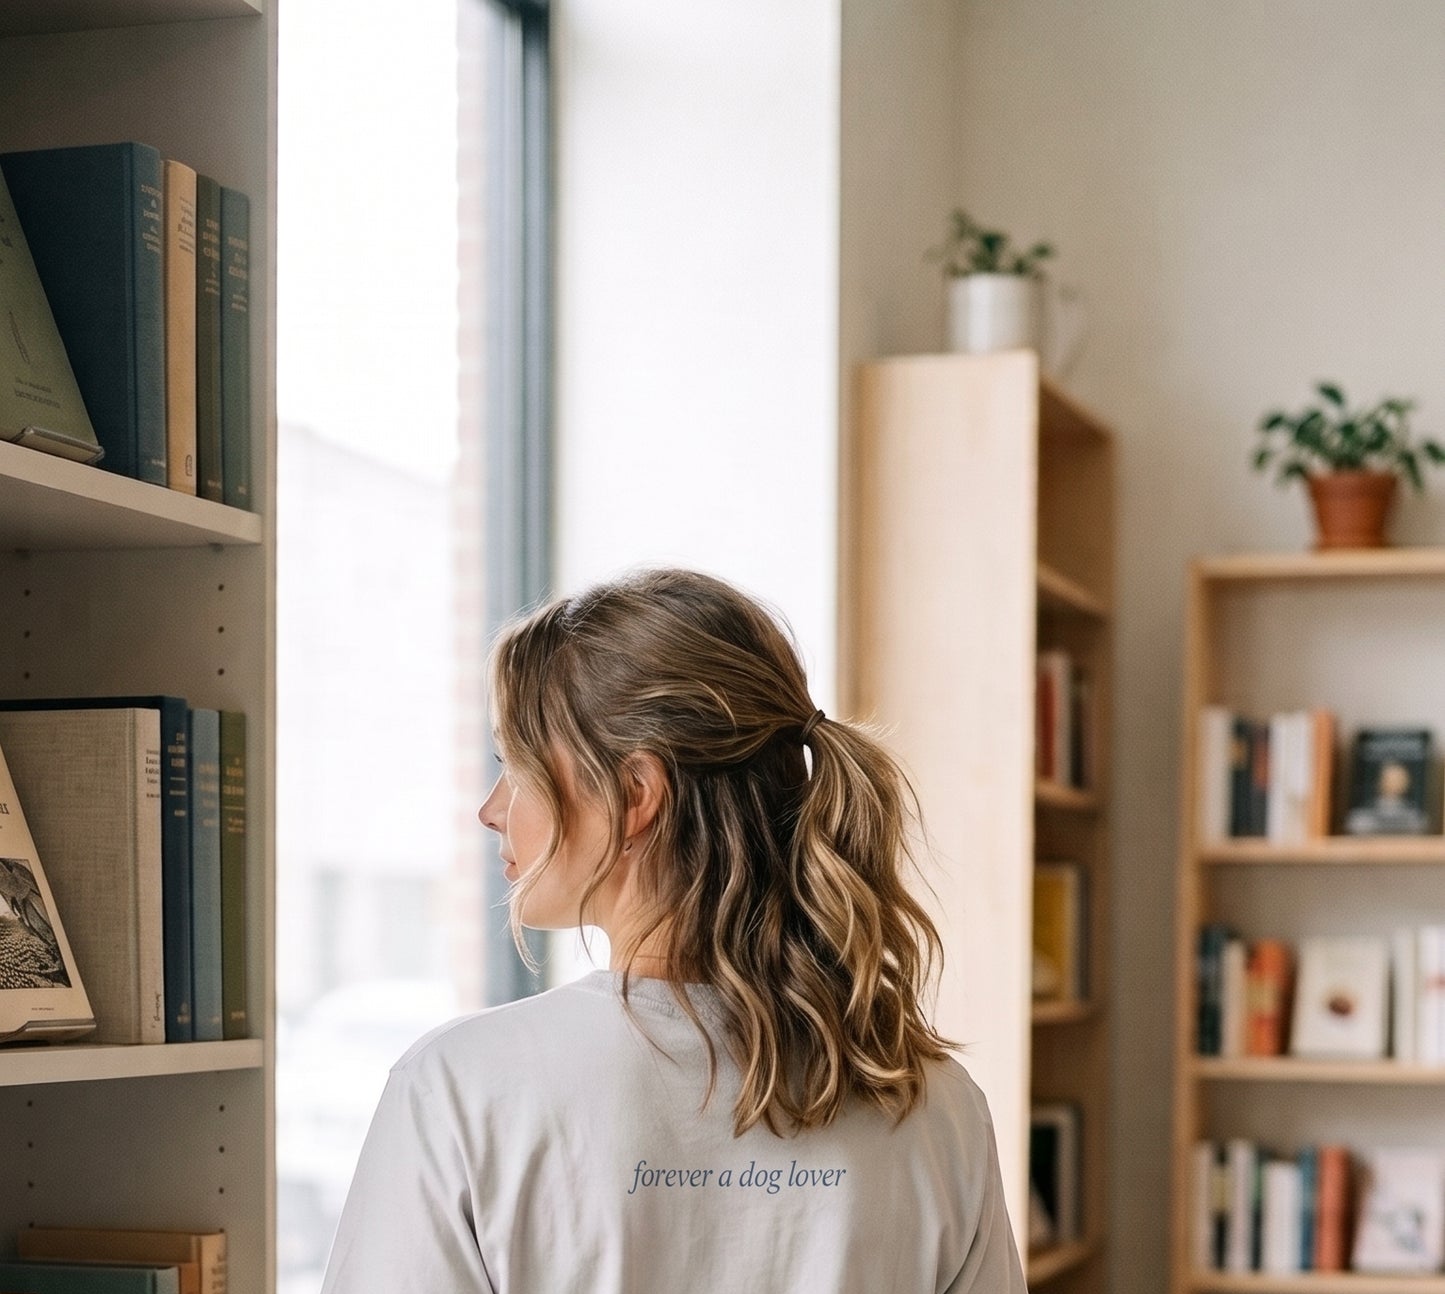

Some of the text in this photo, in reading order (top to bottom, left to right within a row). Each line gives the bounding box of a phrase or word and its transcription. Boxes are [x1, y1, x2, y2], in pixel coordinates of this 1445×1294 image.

[628, 1160, 847, 1195] forever a dog lover
